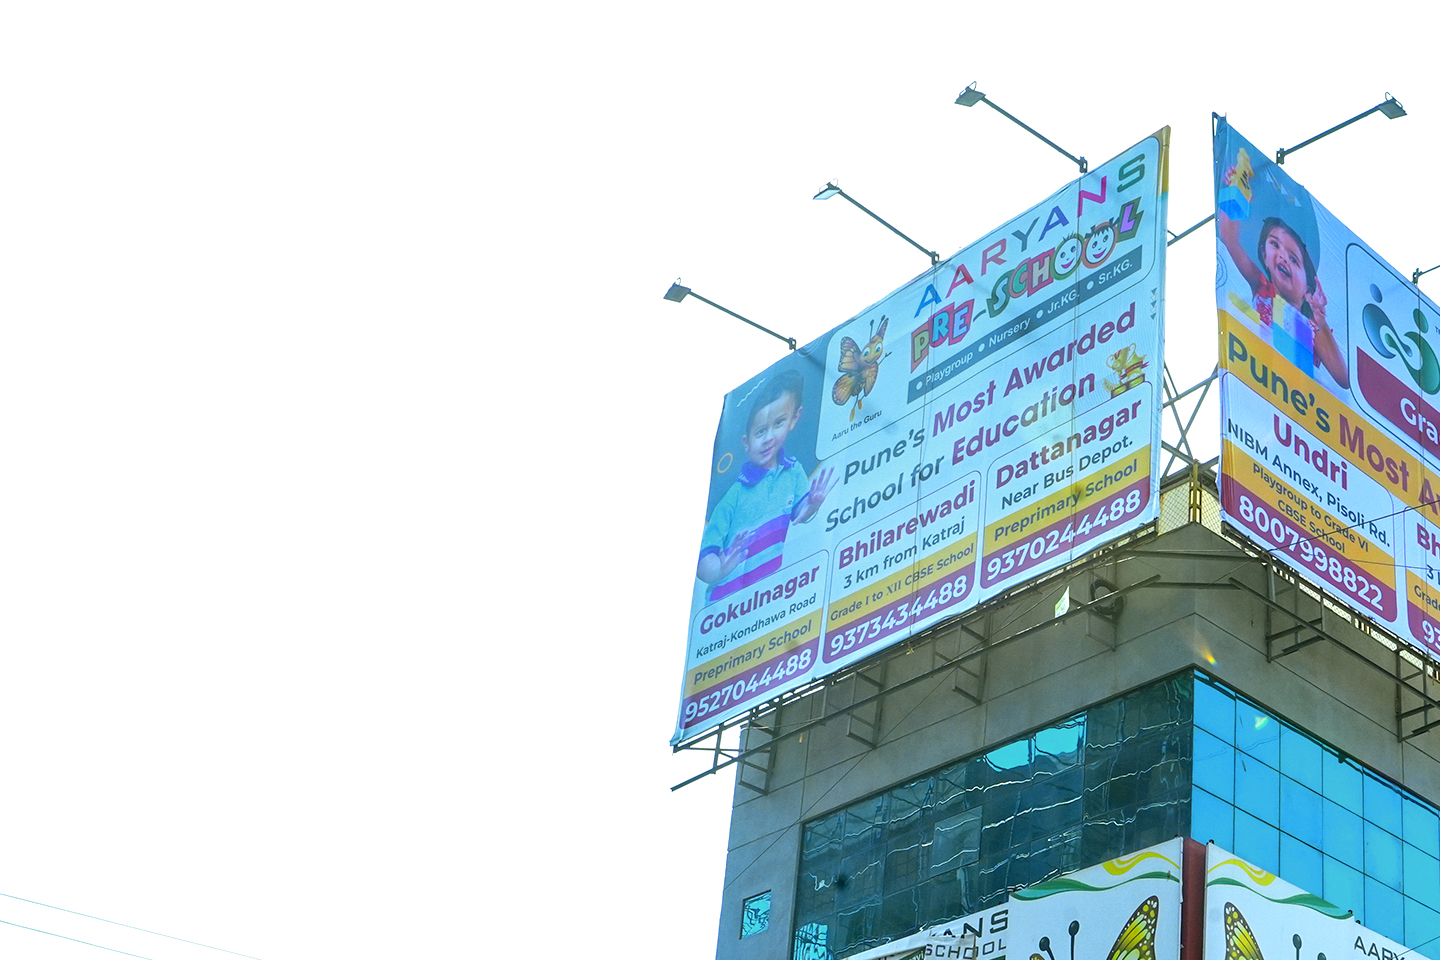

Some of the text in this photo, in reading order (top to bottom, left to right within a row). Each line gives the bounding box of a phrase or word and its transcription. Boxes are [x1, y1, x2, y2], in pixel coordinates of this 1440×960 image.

[914, 153, 1145, 318] AARYANS
[925, 261, 1133, 386] Playgroup Nursery Jr.KG. Sr.KG.
[843, 303, 1135, 485] Pune's Most Awarded
[1228, 332, 1331, 434] Pune's
[1339, 414, 1410, 493] Most
[825, 372, 1095, 533] School for Education
[996, 400, 1141, 489] Dattanagar
[1001, 434, 1133, 510] Near Bus Depot.
[1228, 418, 1390, 548] NIBM Annex, Pisoli Rd.
[1273, 413, 1348, 490] Undri
[838, 479, 976, 570] Bhilarewadi
[986, 489, 1141, 581] 9370244488
[994, 458, 1137, 541] Preprimary School
[1277, 500, 1345, 553] CBSE School
[843, 516, 965, 590] 3 km from Katraj
[1239, 494, 1383, 607] 8007998822
[696, 592, 816, 659] Katraj-Kondhawa Road
[700, 565, 820, 635] Gokulnagar
[830, 574, 967, 658] 9373434488
[684, 648, 812, 722] 9527044488
[694, 620, 812, 686] Preprimary School
